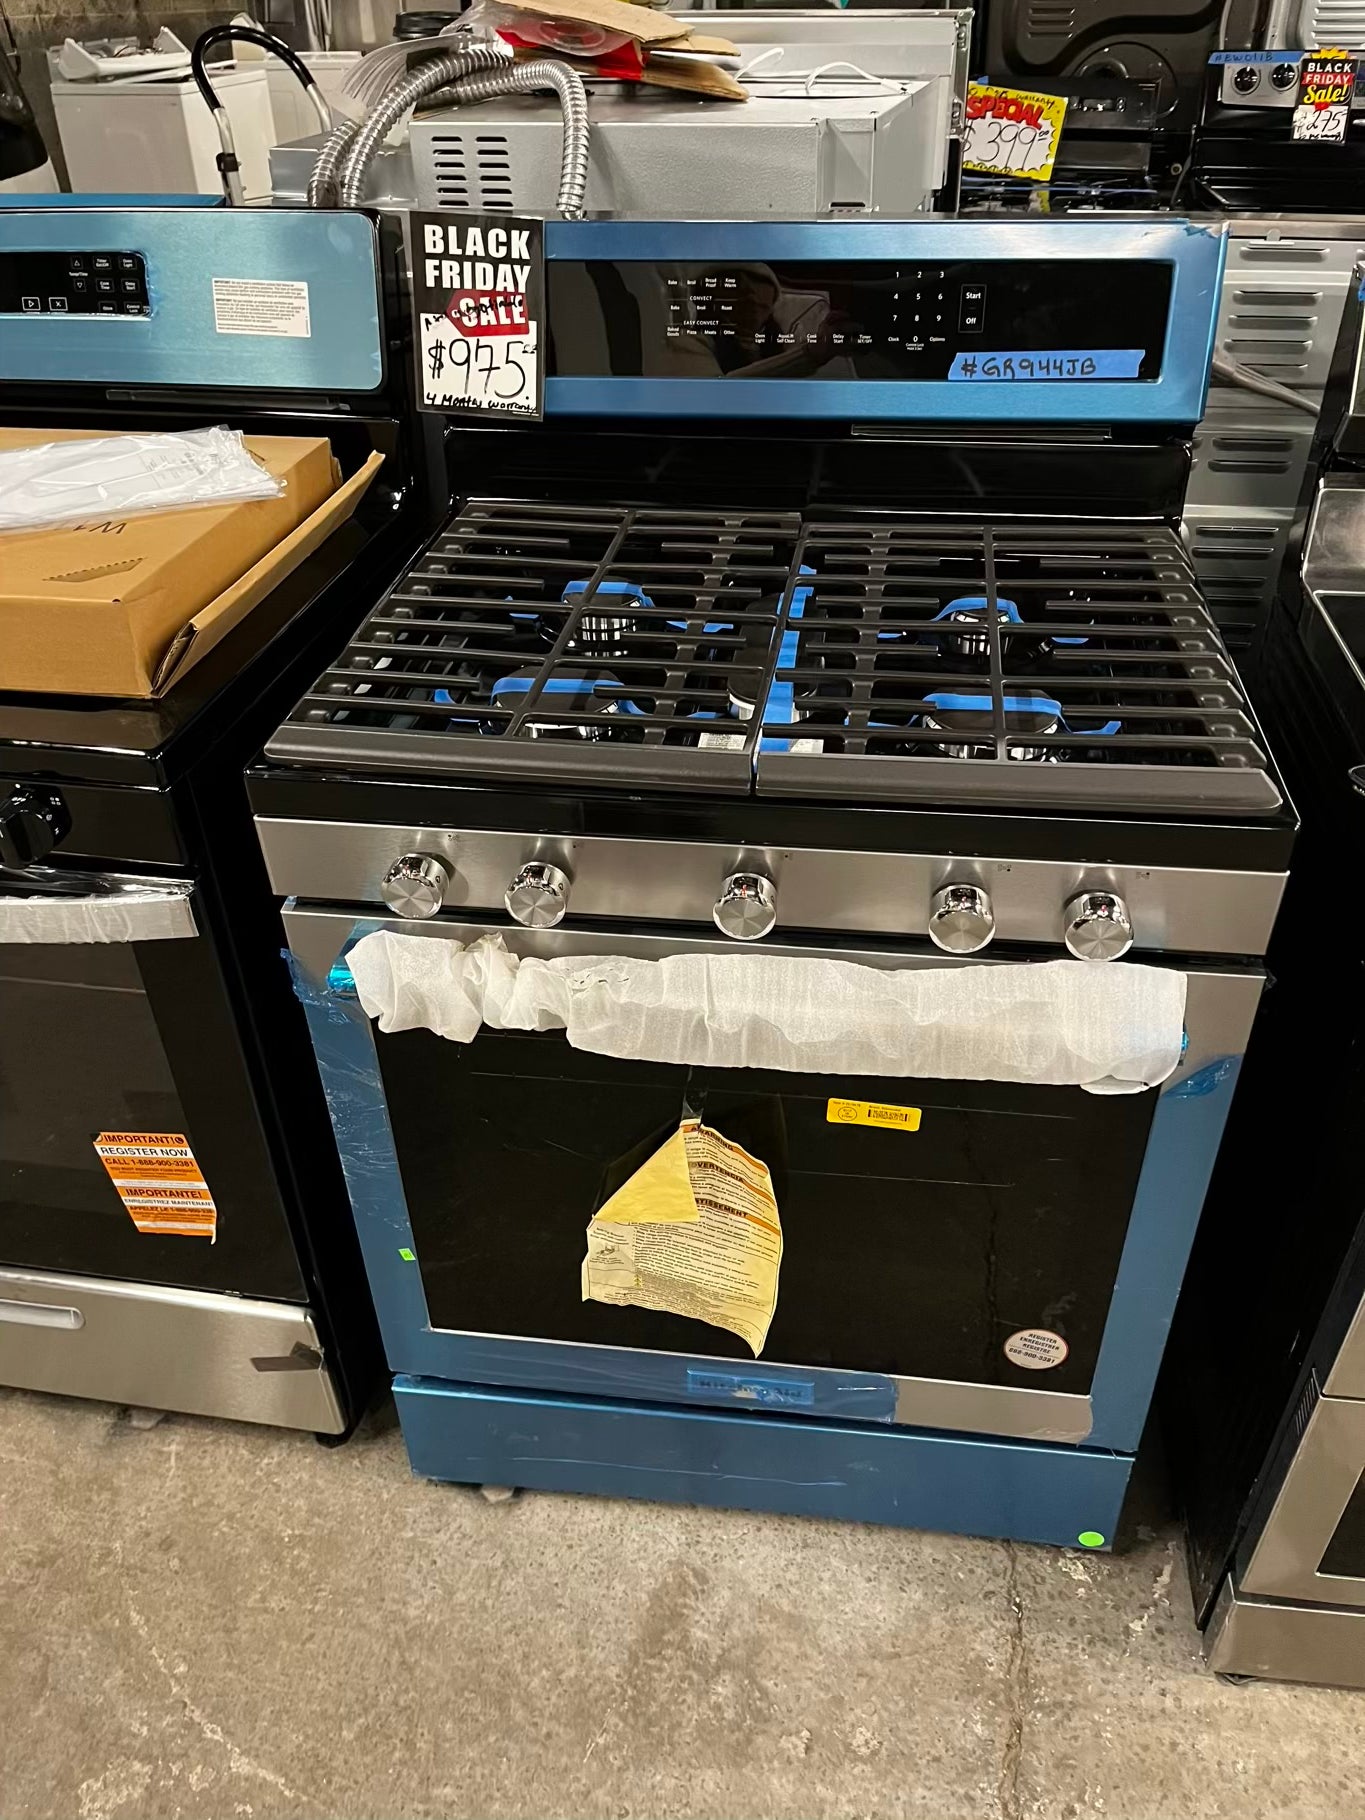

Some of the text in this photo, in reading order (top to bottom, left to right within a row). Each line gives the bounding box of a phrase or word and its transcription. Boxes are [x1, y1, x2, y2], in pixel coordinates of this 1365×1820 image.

[1307, 62, 1353, 73] BLACK
[1305, 73, 1351, 84] FRIDAY
[1303, 84, 1348, 104] Sale!
[965, 94, 1046, 130] SPECIAL
[423, 224, 531, 260] BLACK
[424, 258, 532, 294] FRIDAY
[896, 271, 900, 279] 1
[940, 271, 945, 279] 3
[459, 294, 526, 328] SALE
[914, 314, 919, 322] 8
[936, 314, 942, 322] 9
[965, 317, 977, 325] Off
[426, 392, 437, 404] 4
[104, 1135, 175, 1144] IMPORTANT!
[101, 1147, 188, 1157] REGISTER NOW
[105, 1158, 130, 1166] CALL
[126, 1188, 202, 1199] IMPORTANTE!
[1028, 1333, 1057, 1344] REGISTER
